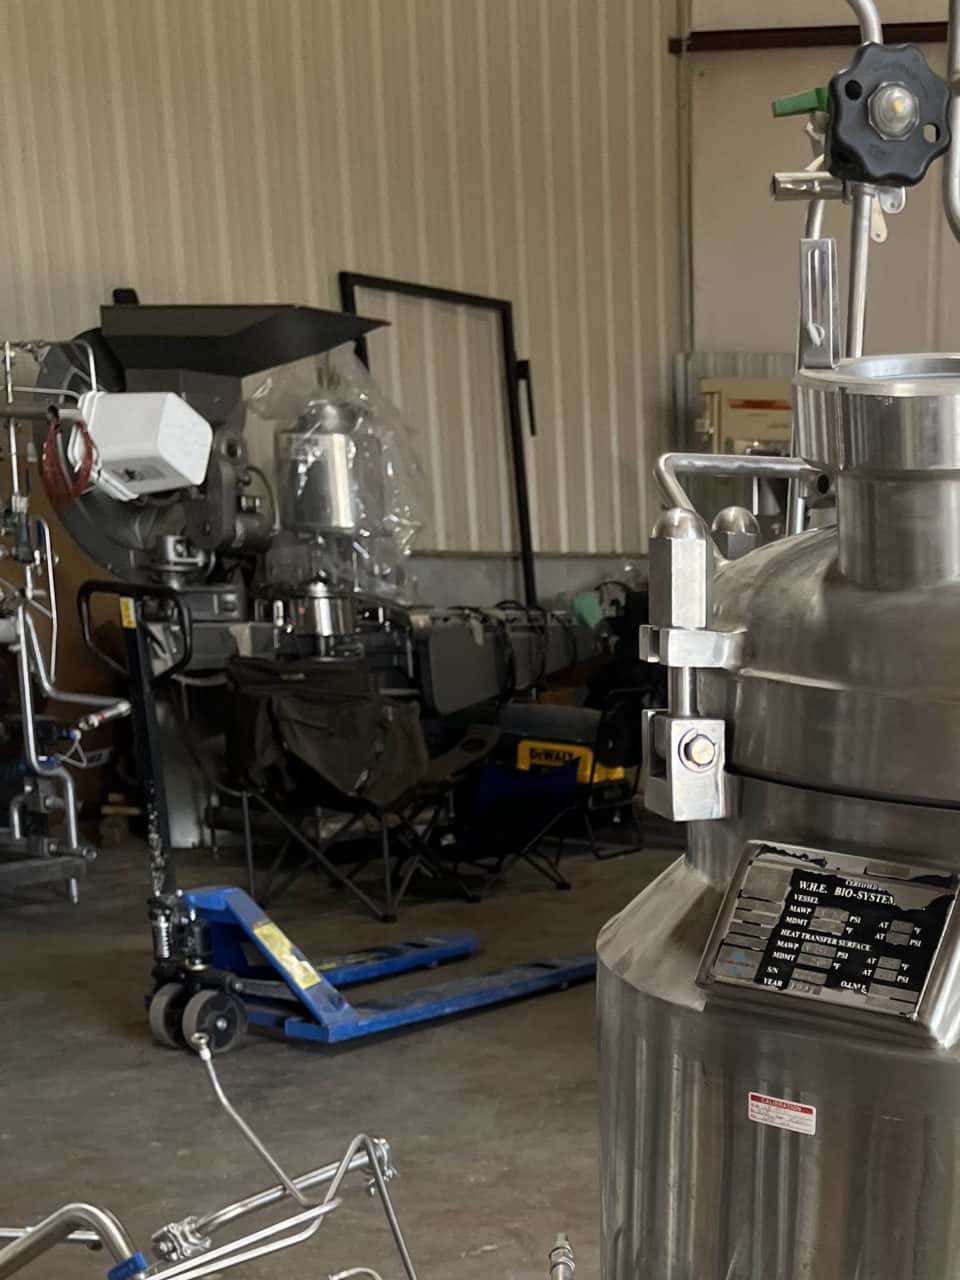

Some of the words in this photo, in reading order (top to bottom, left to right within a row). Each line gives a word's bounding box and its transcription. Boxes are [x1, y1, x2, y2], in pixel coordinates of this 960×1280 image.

[794, 894, 820, 904] VESSEL
[799, 880, 828, 894] W.H.E.
[789, 904, 812, 915] MAWP
[849, 915, 862, 924] PSI
[878, 921, 890, 930] AT
[780, 928, 801, 939] HEAT
[801, 932, 838, 946] TRANSFER
[838, 938, 872, 952] SURFACE
[785, 916, 808, 927] MDMT
[874, 932, 885, 941] AT
[909, 939, 922, 948] PSI
[776, 940, 800, 951] MAWP
[836, 951, 849, 960] PSI
[866, 957, 878, 965] AT
[772, 951, 797, 962] MDMT
[862, 968, 873, 977] AT
[896, 976, 910, 984] PSI
[762, 978, 784, 988] YEAR
